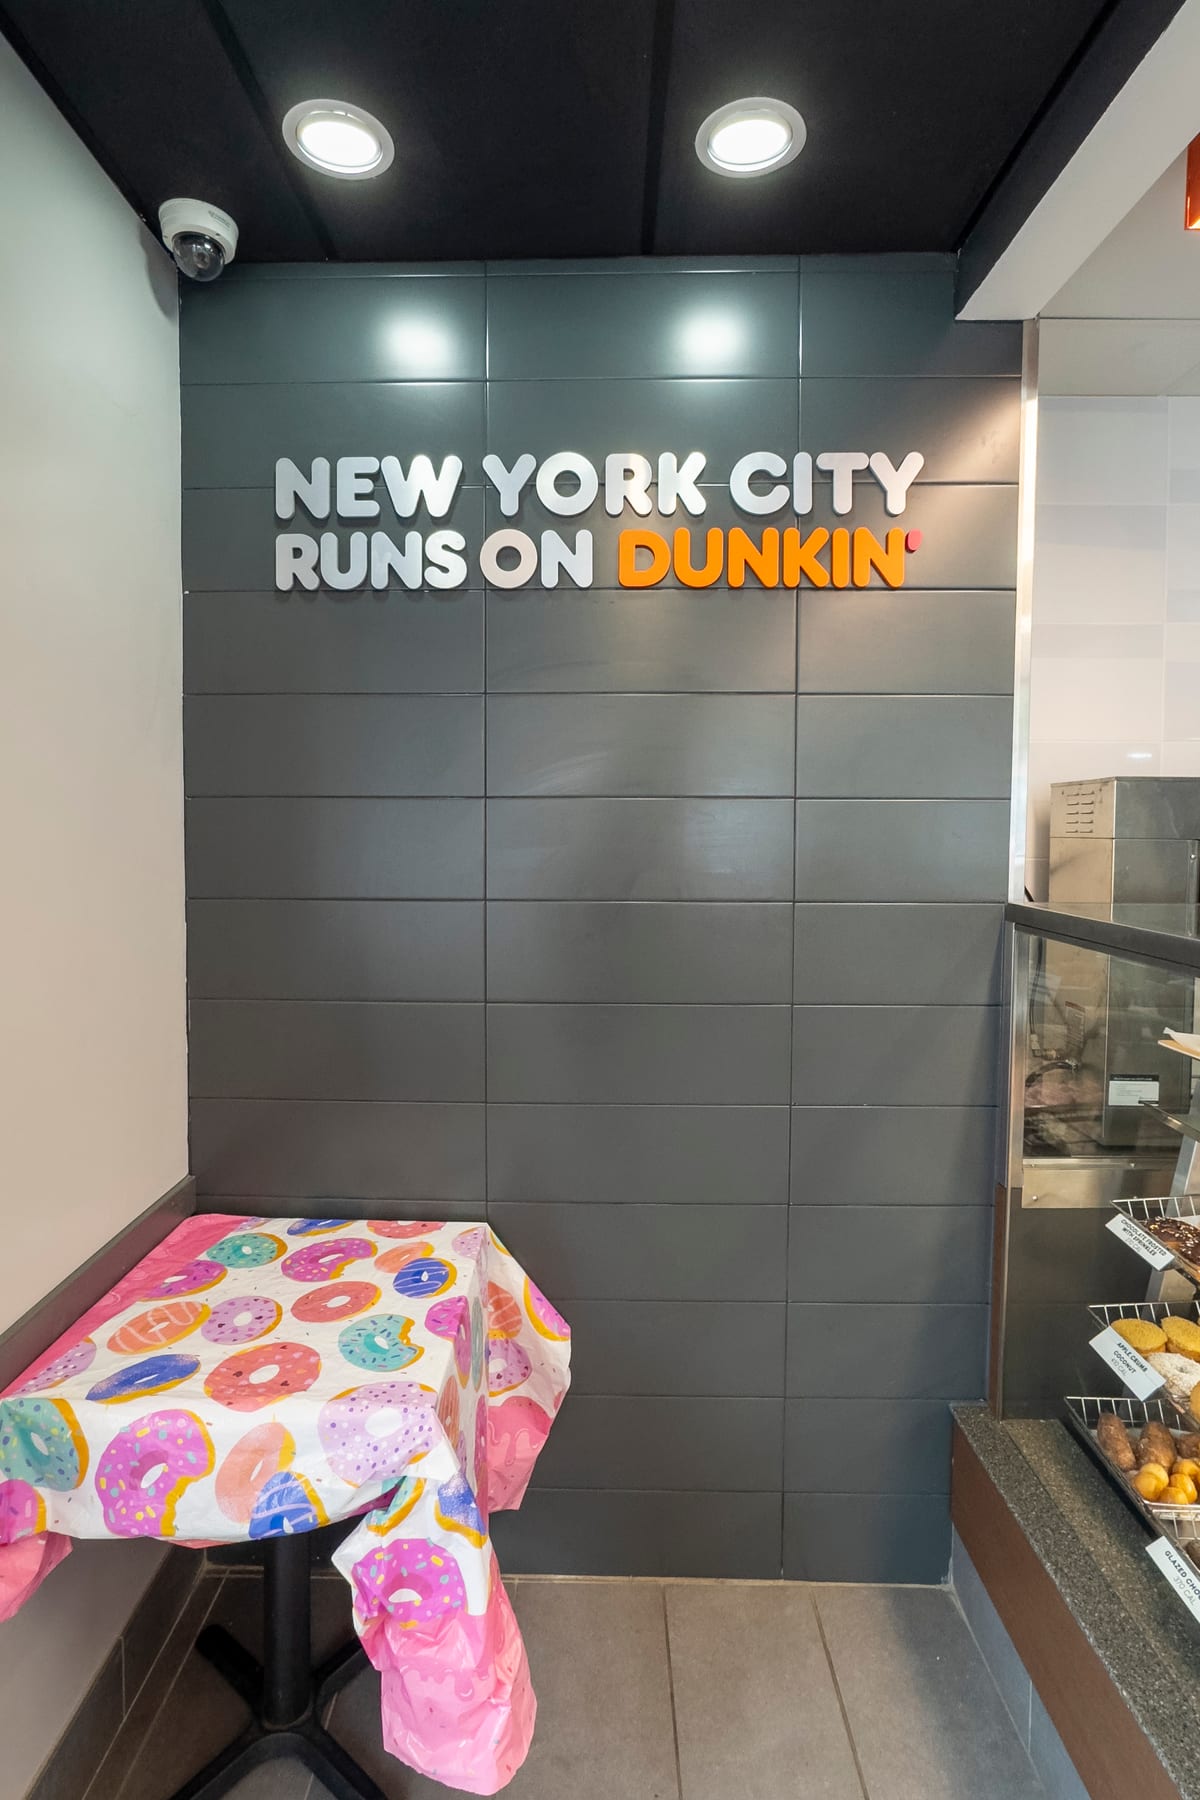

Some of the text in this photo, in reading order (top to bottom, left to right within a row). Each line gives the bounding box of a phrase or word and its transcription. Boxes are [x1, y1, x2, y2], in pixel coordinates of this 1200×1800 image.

[275, 451, 925, 519] NEW YORK CITY
[275, 527, 923, 590] RUNS ON DUNKIN'
[1120, 1218, 1146, 1240] CHOCOLATE
[1144, 1239, 1167, 1256] FROSTED
[1113, 1350, 1136, 1374] COCONUT
[1117, 1342, 1132, 1357] APPLE
[1164, 1550, 1187, 1578] GLAZED
[1184, 1588, 1196, 1606] CAL
